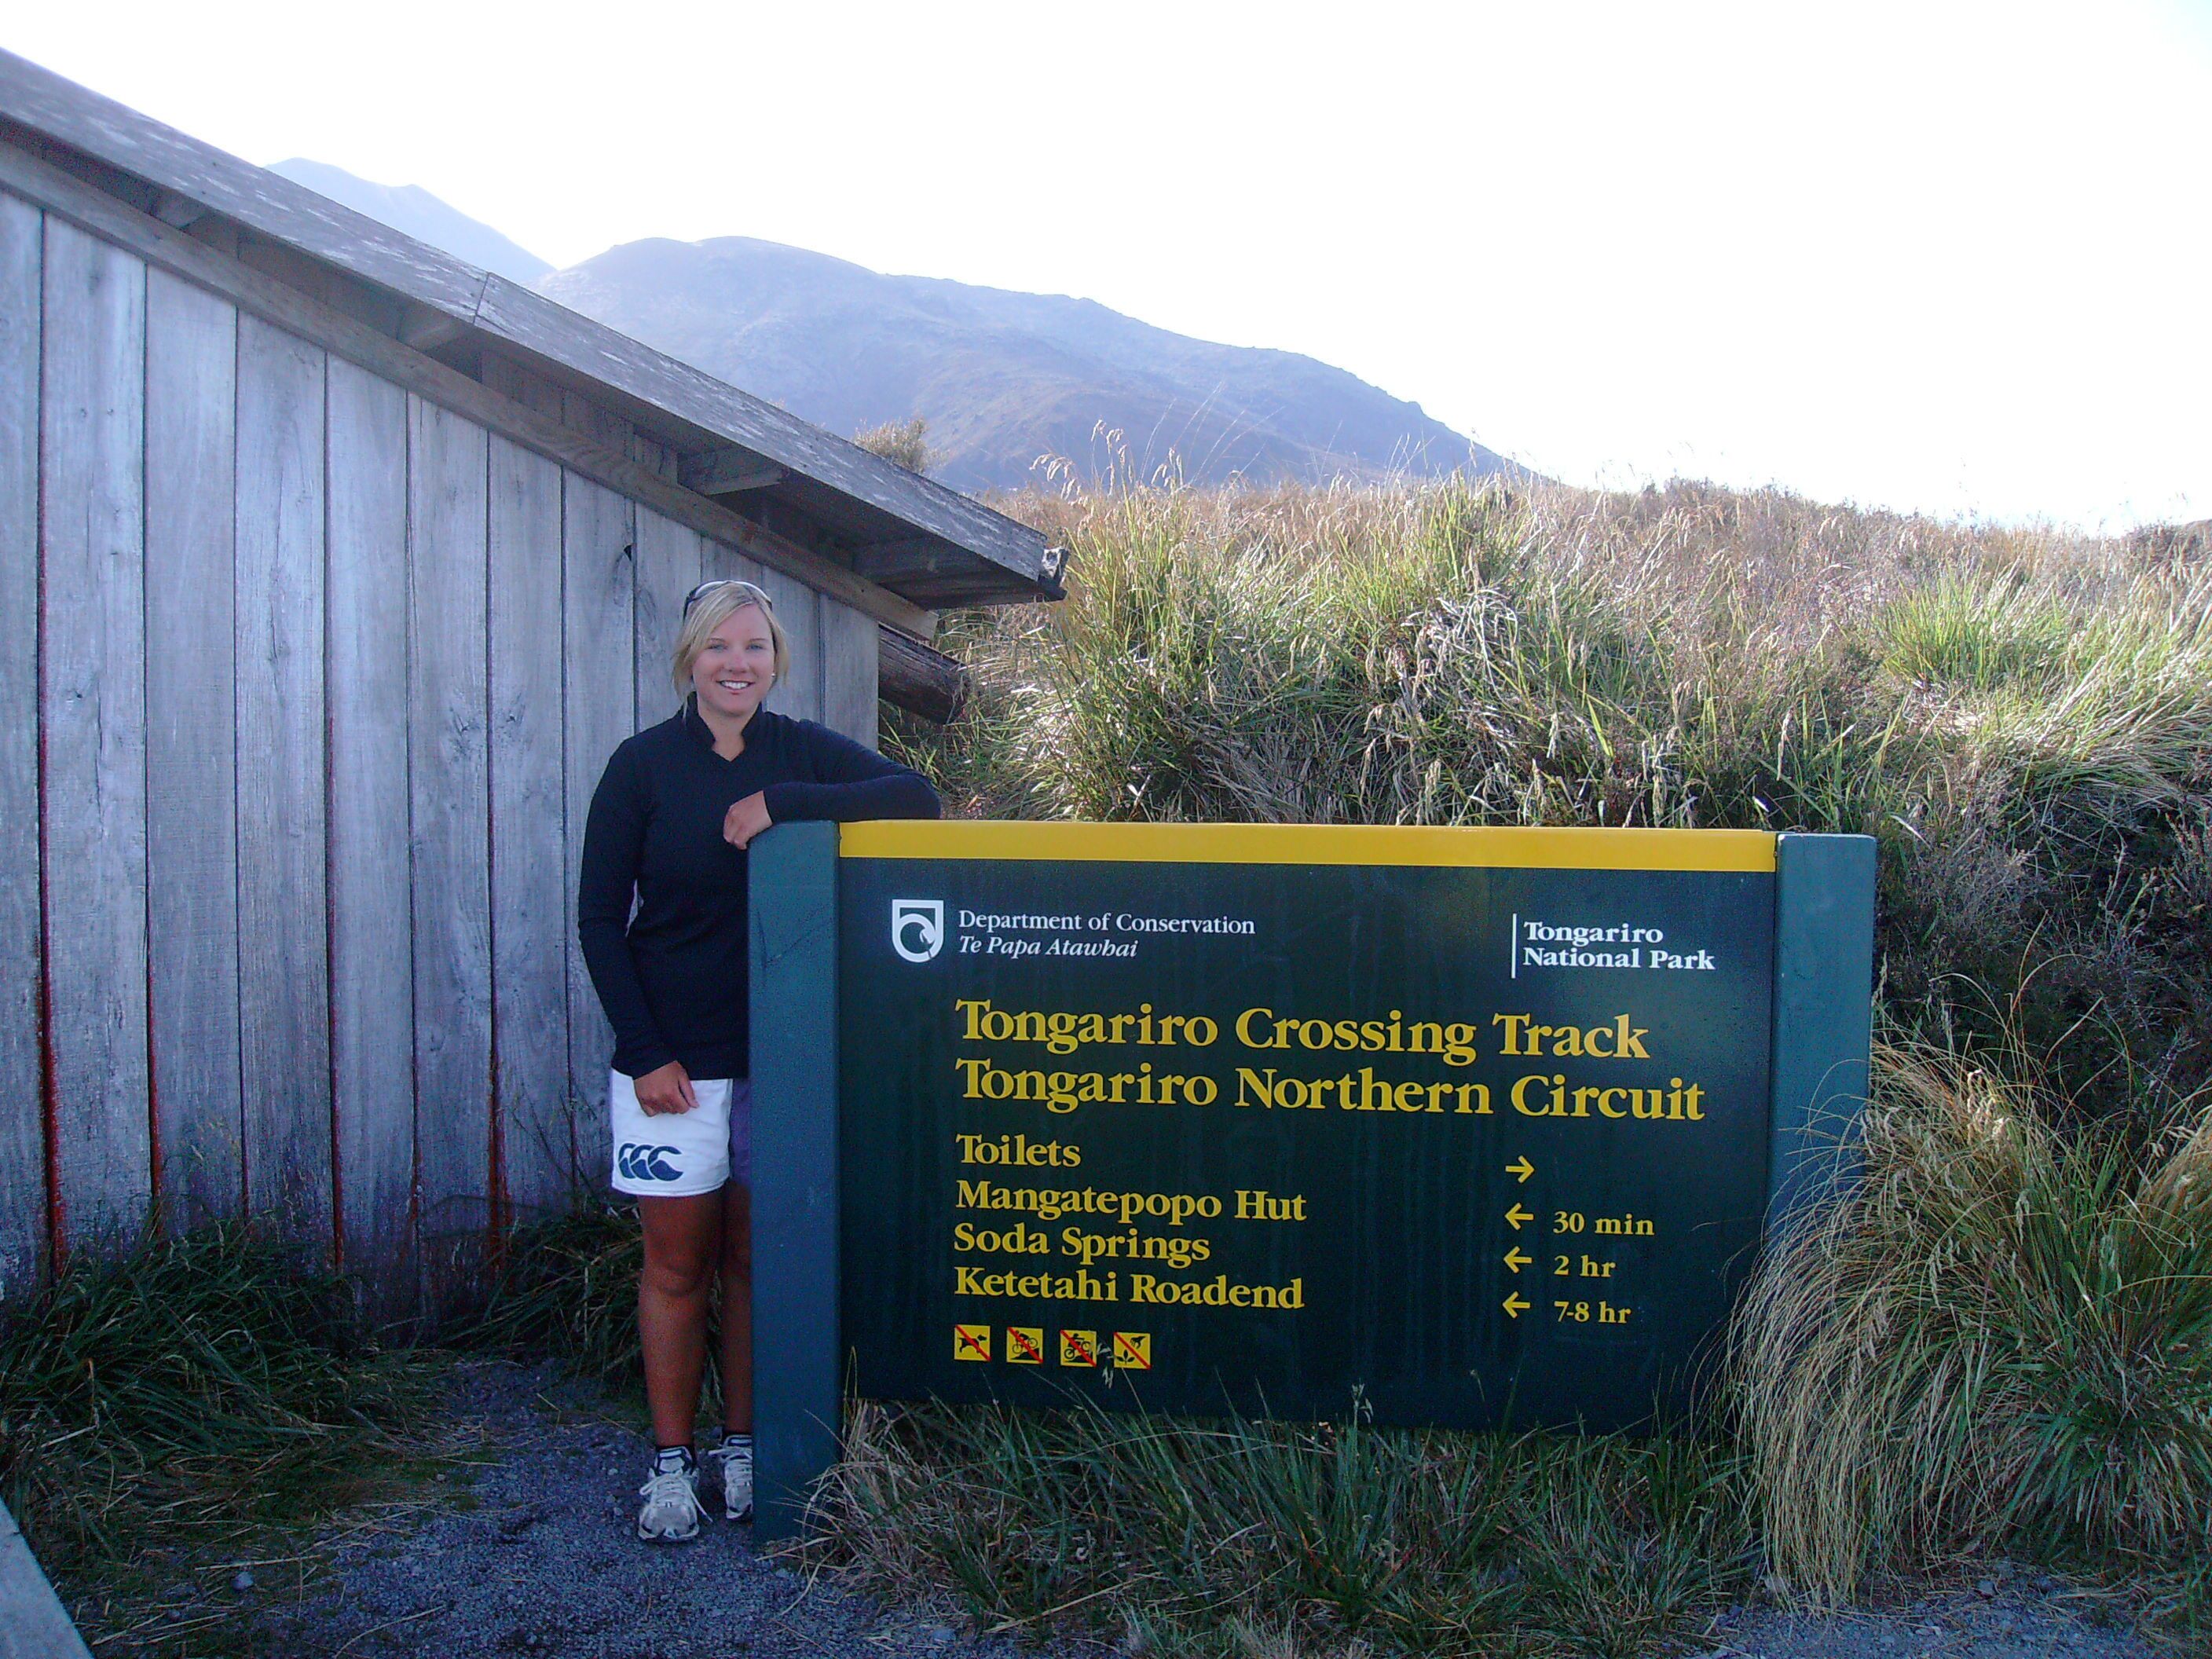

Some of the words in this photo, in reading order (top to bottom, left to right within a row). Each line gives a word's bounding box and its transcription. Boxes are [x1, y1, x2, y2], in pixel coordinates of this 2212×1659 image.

[958, 910, 1082, 933] Department
[1088, 912, 1111, 931] of
[1115, 914, 1256, 934] Conservation
[1523, 921, 1664, 947] Tongariro
[960, 935, 982, 954] Te
[986, 936, 1041, 959] Papa
[1045, 938, 1139, 958] Atawhai
[1522, 947, 1642, 969] National
[1649, 949, 1716, 970] Park
[954, 998, 1218, 1055] Tongariro
[1236, 1008, 1477, 1067] Crossing
[1492, 1013, 1651, 1059] Track
[954, 1057, 1218, 1114] Tongariro
[1234, 1067, 1494, 1114] Northern
[1511, 1074, 1705, 1120] Circuit
[955, 1133, 1081, 1167] Toilets
[955, 1180, 1222, 1225] Mangatepopo
[1234, 1190, 1307, 1221] Hut
[1553, 1210, 1585, 1234] 30
[1595, 1213, 1655, 1236] min
[954, 1222, 1050, 1254] Soda
[1061, 1227, 1210, 1269] Springs
[1554, 1255, 1569, 1276] 2
[1580, 1254, 1616, 1277] hr
[954, 1266, 1119, 1302] Ketetahi
[1130, 1274, 1305, 1309] Roadend
[1554, 1301, 1590, 1322] 7-8
[1599, 1301, 1632, 1324] hr
